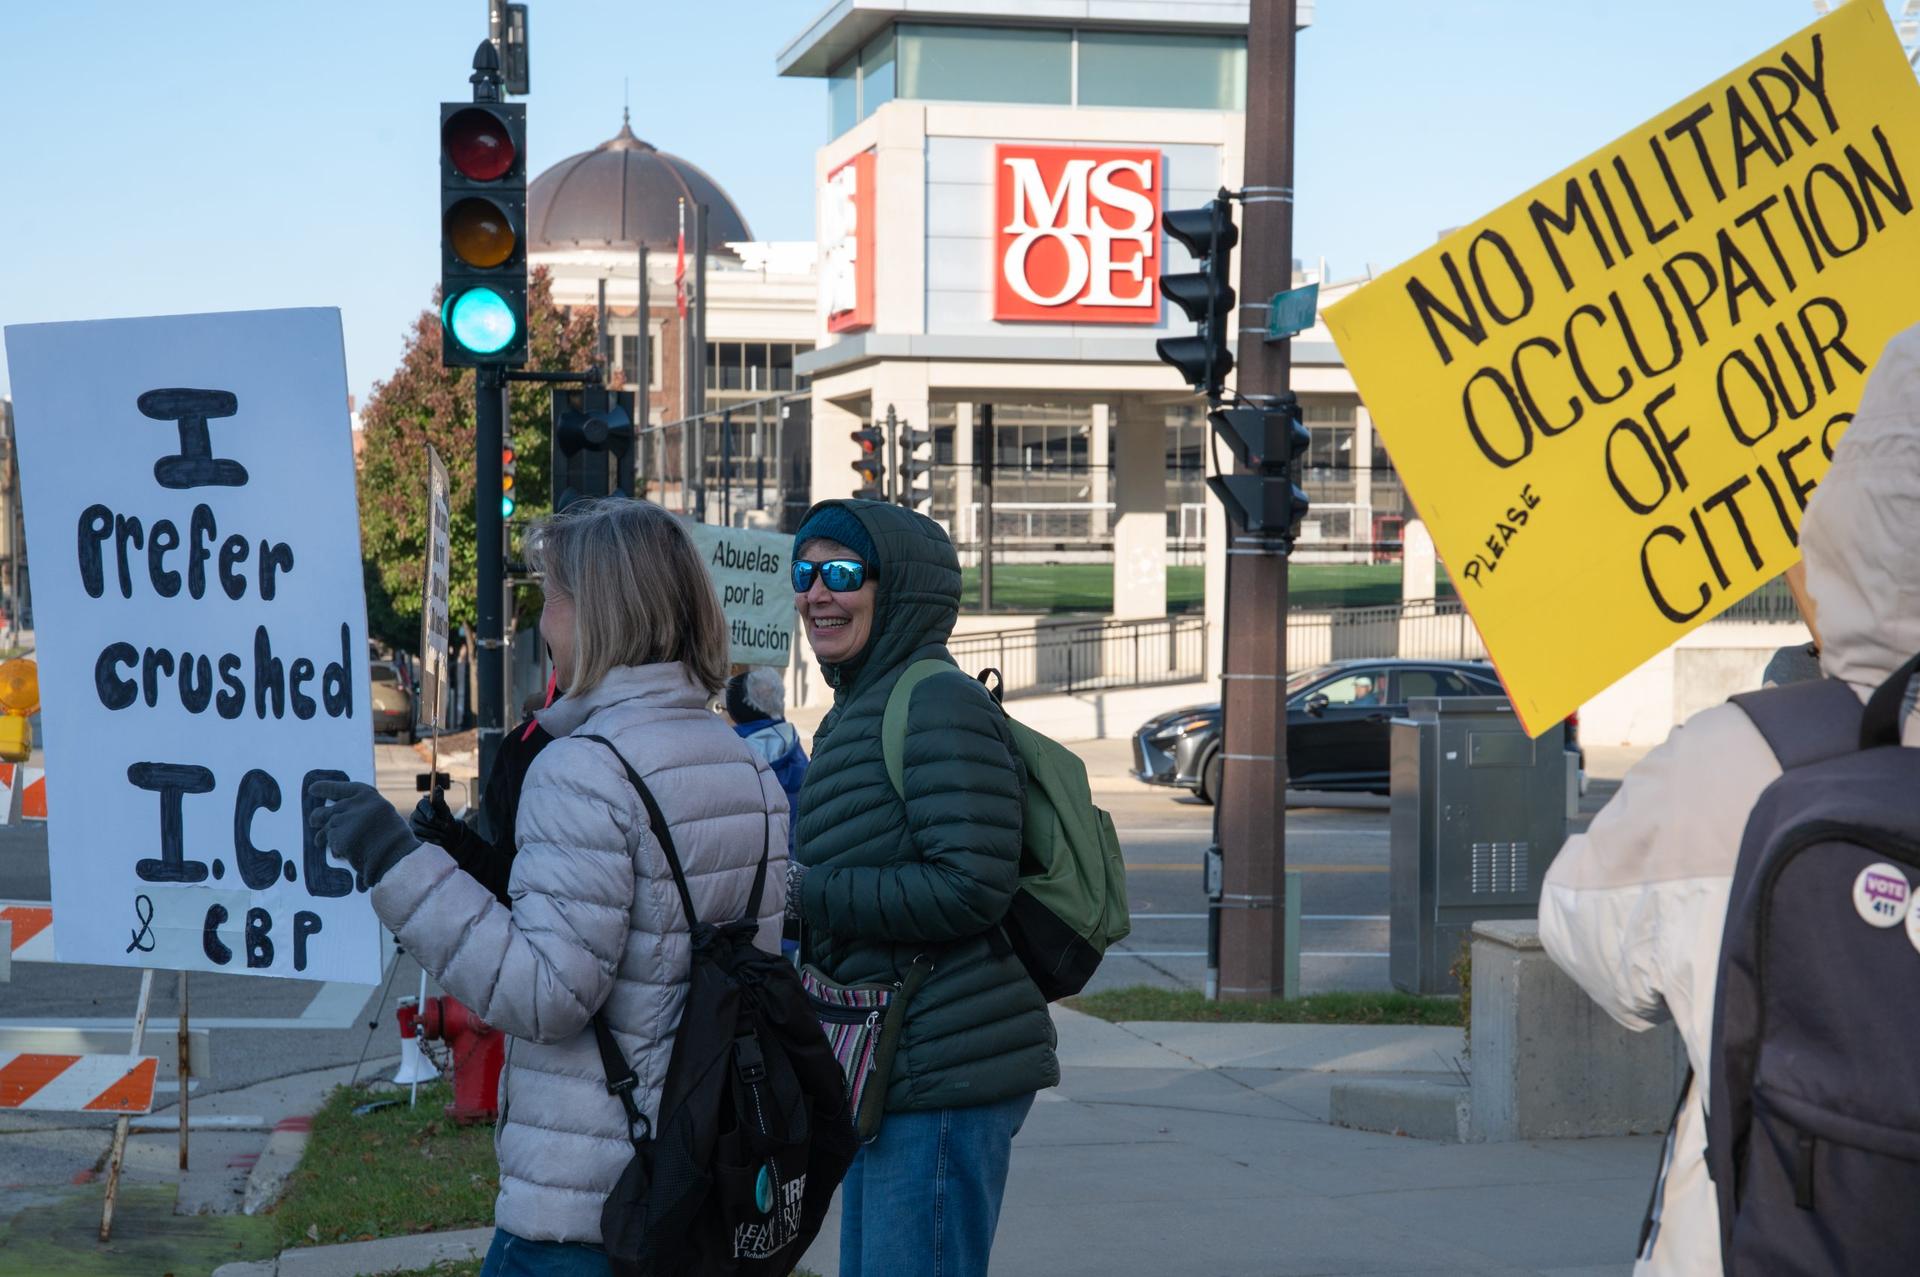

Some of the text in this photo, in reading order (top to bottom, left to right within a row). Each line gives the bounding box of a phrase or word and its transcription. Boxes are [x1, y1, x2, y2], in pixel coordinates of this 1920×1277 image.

[1405, 33, 1839, 366] NO MILITARY
[1462, 125, 1914, 469] OCCUPATION
[137, 387, 249, 489] I
[1605, 298, 1868, 515] OF OUR
[712, 540, 780, 574] Abuelas
[1464, 484, 1541, 588] PLEASE
[724, 582, 764, 608] por la
[731, 619, 789, 651] titución
[95, 622, 353, 720] crushed
[1867, 876, 1904, 898] VOTE
[1873, 900, 1896, 916] 411
[203, 903, 322, 972] CBP
